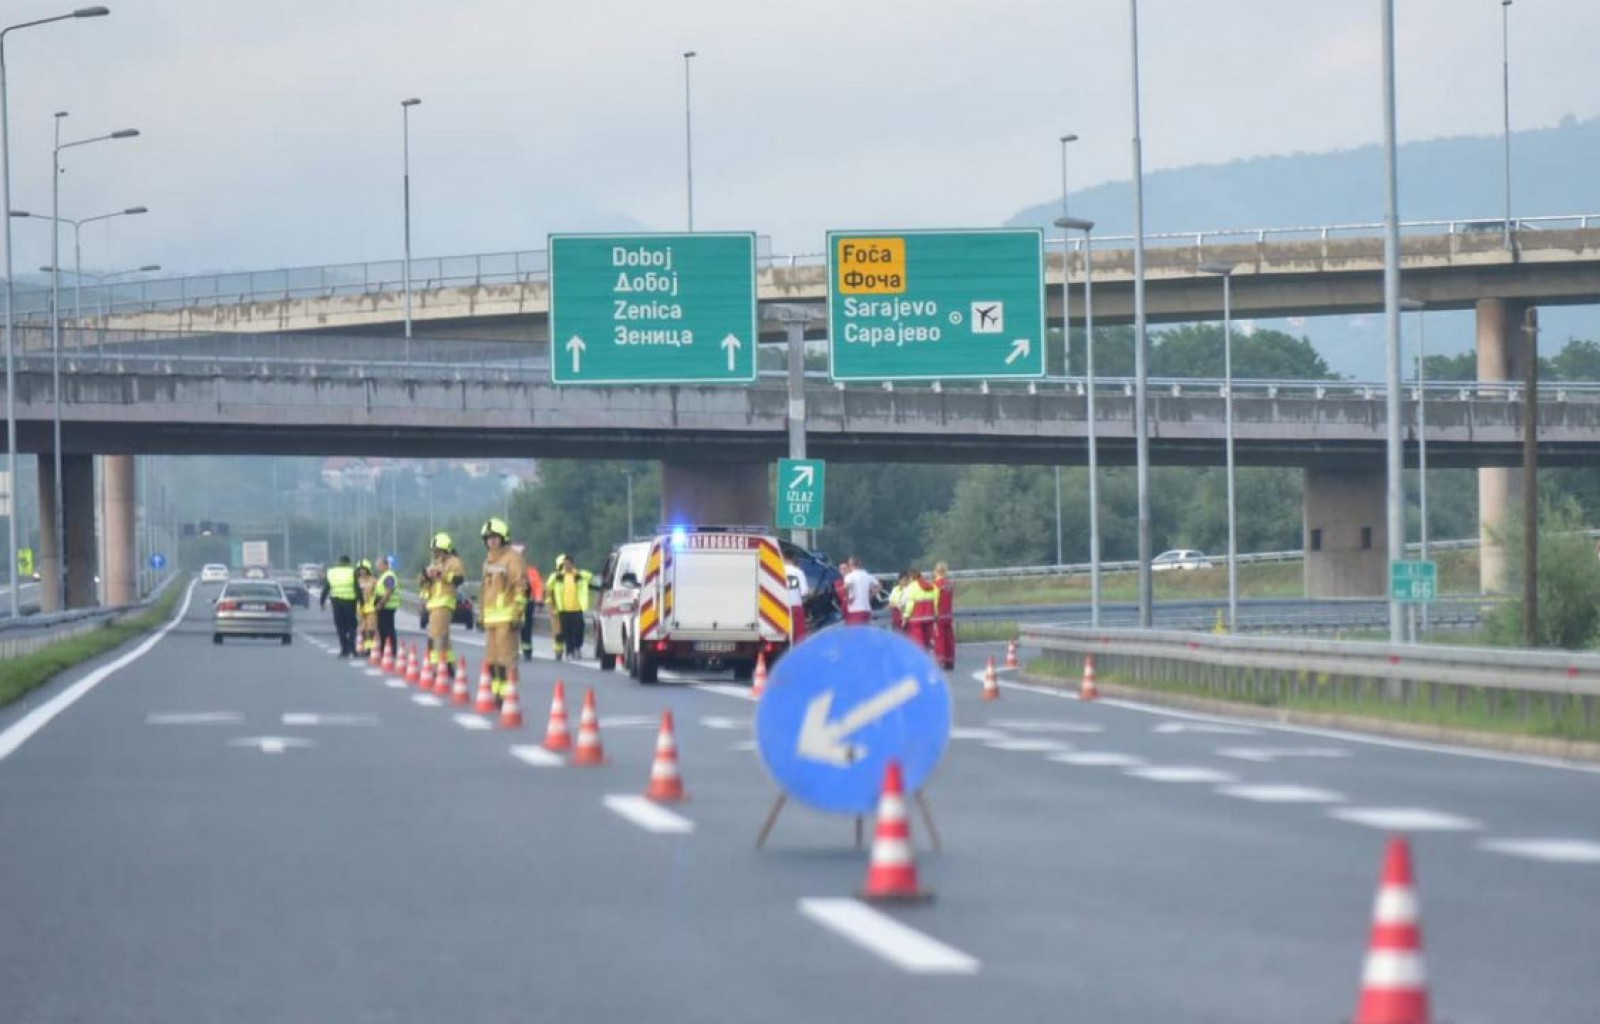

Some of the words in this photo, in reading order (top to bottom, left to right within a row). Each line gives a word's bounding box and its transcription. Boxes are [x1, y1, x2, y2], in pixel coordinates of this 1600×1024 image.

[612, 247, 672, 270] Doboj
[842, 244, 893, 264] Foča
[613, 272, 679, 296] Добој
[843, 270, 901, 289] Фоча
[614, 300, 682, 320] Zenica
[844, 297, 937, 321] Sarajevo
[614, 326, 693, 347] Зеница
[844, 322, 941, 347] Сарајево
[786, 490, 814, 503] IZLAZ
[788, 502, 811, 514] EXIT
